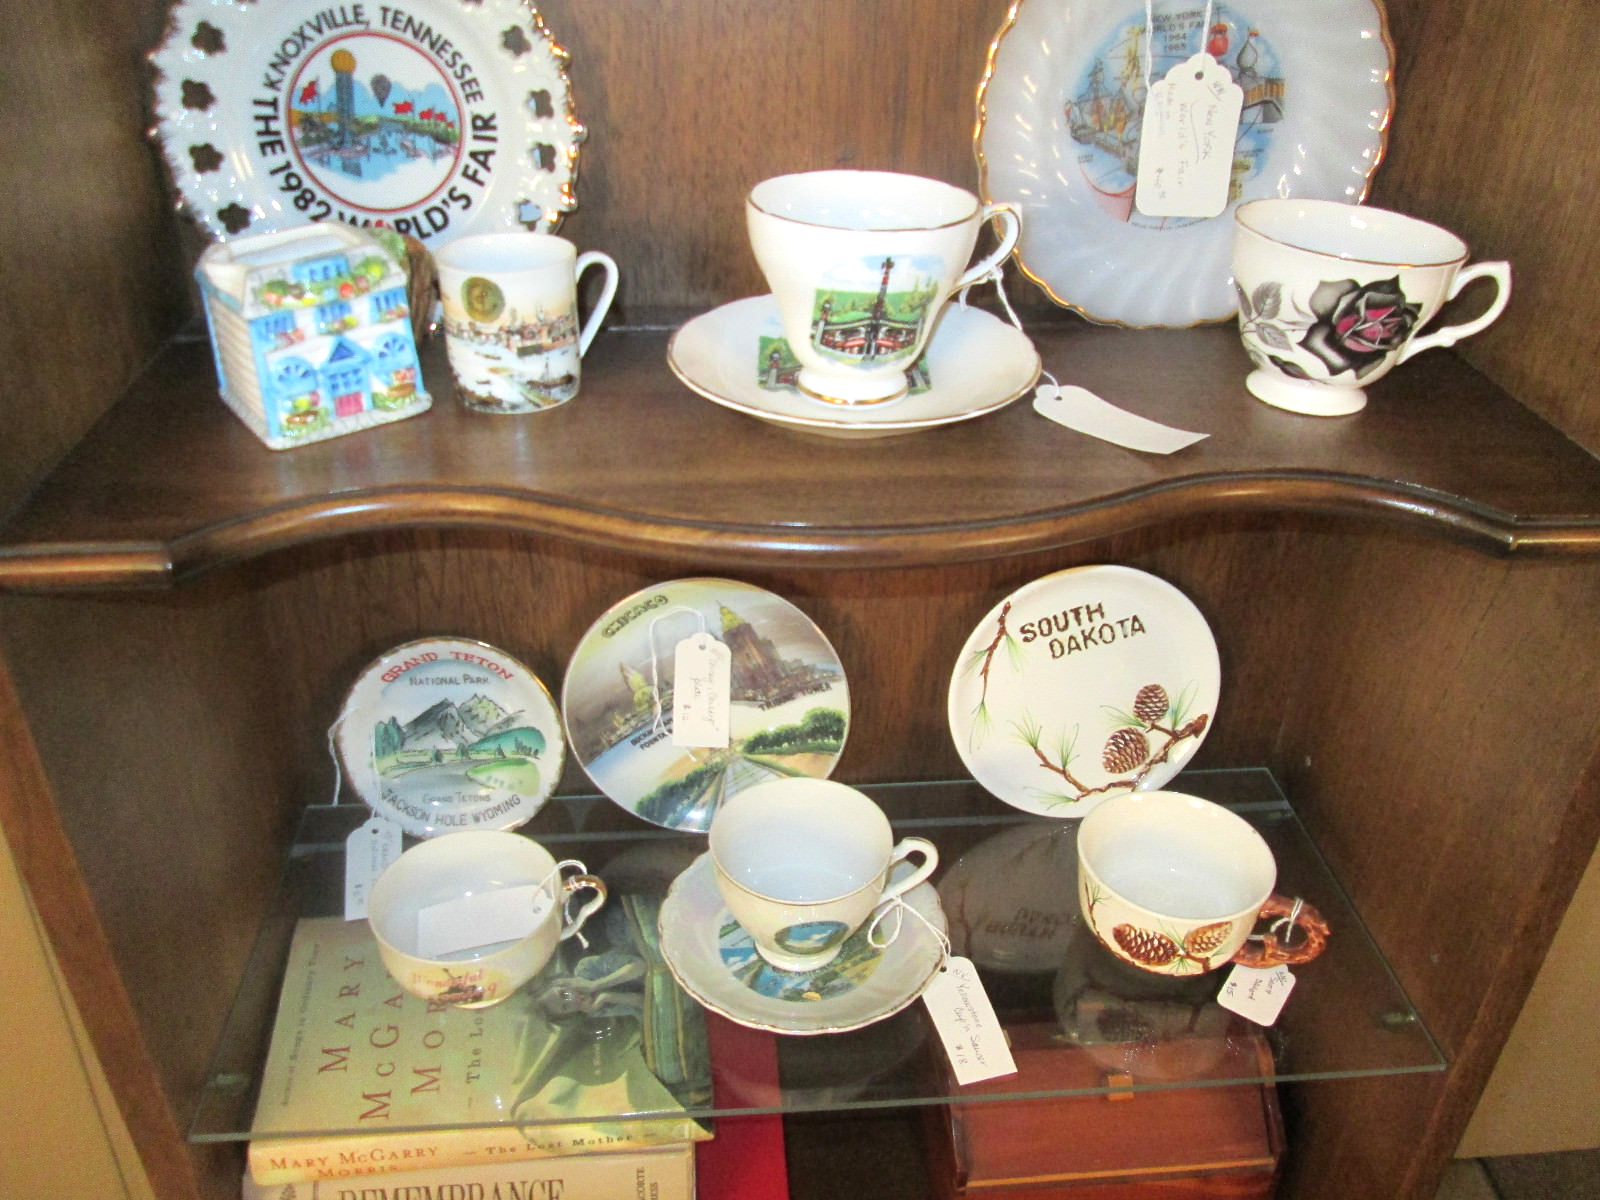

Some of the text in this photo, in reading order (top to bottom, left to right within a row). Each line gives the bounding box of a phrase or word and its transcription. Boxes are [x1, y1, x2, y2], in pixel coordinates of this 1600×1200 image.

[263, 4, 484, 104] KNOXVILLE, TENNESSEE
[253, 99, 498, 239] THE 1982 WRLD'S FAIR
[602, 594, 669, 639] CHICAGO
[1019, 602, 1105, 643] SOUTH
[1049, 614, 1147, 660] DAKOTA
[381, 650, 515, 683] GRAND TETON
[381, 788, 521, 826] JACKSON HOLE WYOMING
[318, 956, 365, 1075] MARY
[465, 1047, 481, 1084] The
[270, 1156, 329, 1170] MARY
[485, 1146, 517, 1155] The
[526, 1140, 563, 1151] Lost
[572, 1134, 633, 1147] Mother
[317, 1164, 398, 1178] MORRIS
